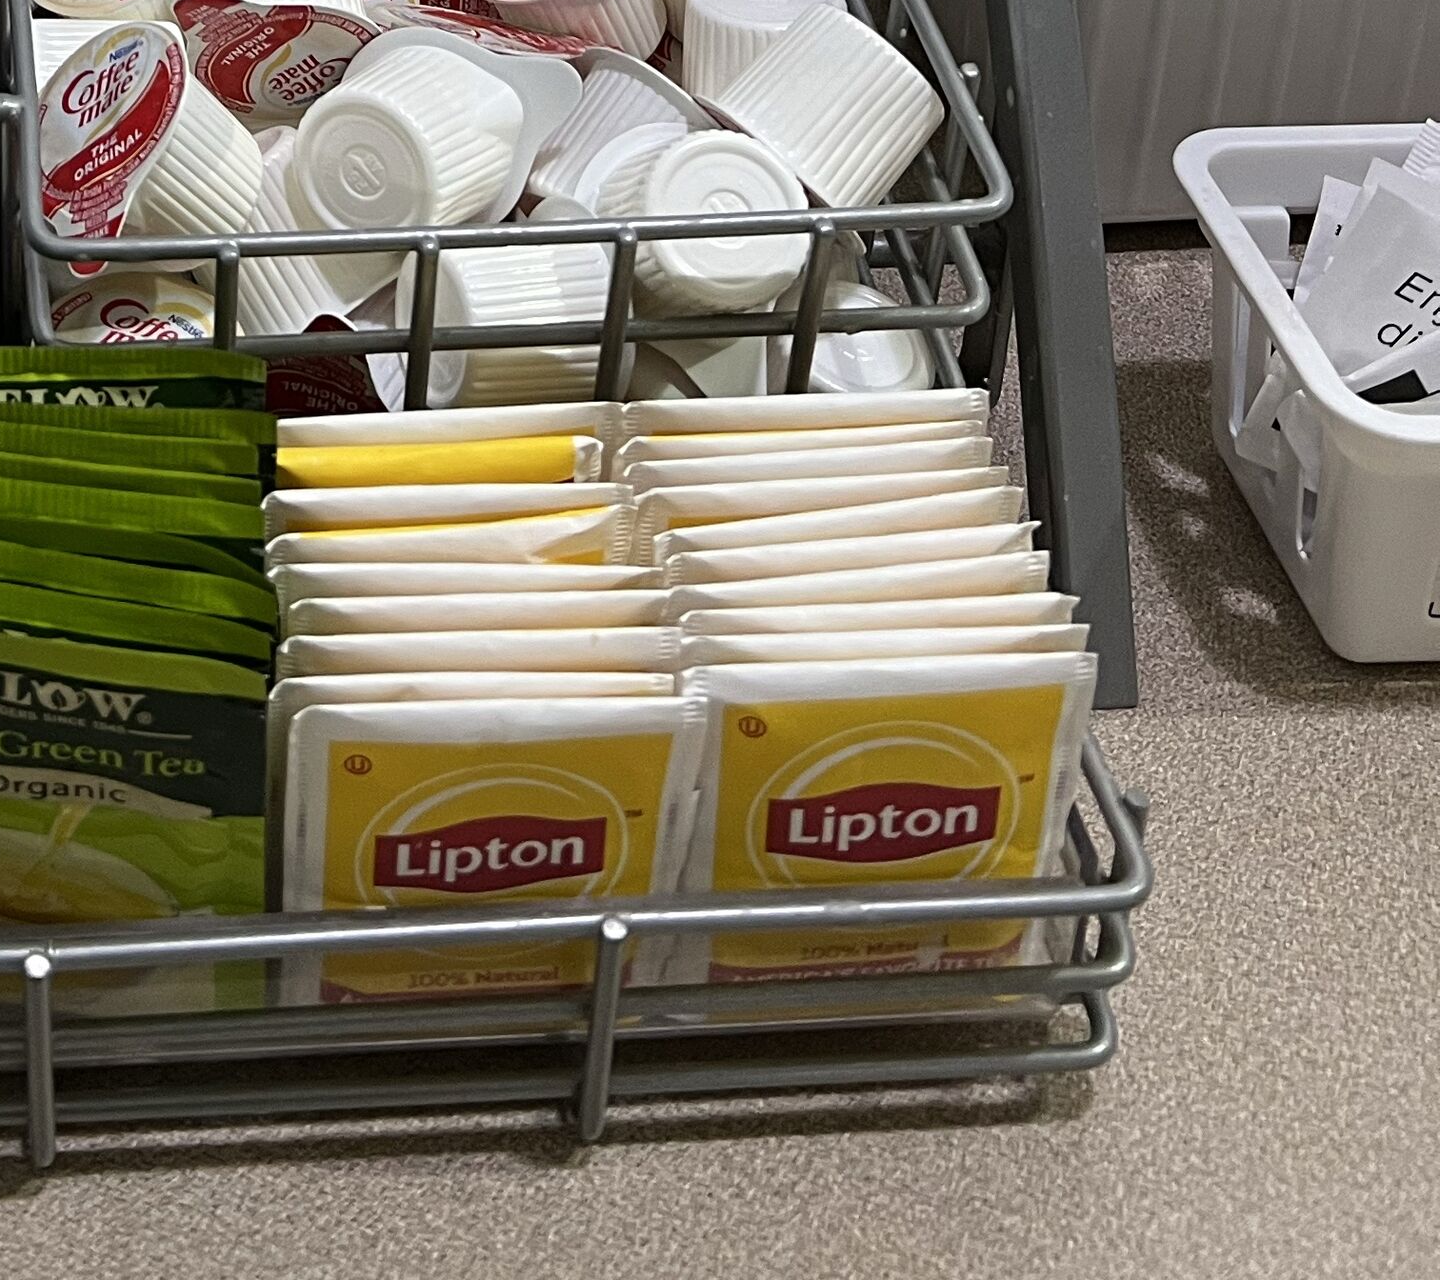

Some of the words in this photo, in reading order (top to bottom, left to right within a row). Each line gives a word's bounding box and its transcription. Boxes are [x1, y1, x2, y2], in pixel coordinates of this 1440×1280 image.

[220, 25, 275, 66] ORIGINAL
[246, 42, 272, 60] THE
[62, 49, 139, 114] Coffee
[268, 54, 320, 90] mate
[78, 74, 133, 128] mate
[74, 128, 143, 181] ORIGINAL
[90, 130, 119, 158] THE
[100, 298, 178, 345] Coffe
[282, 381, 359, 412] ORIGINAL
[305, 396, 337, 413] THE
[42, 713, 86, 728] SINCE
[131, 750, 207, 779] Tea
[788, 804, 980, 852] Lipton
[396, 836, 586, 883] Lipton
